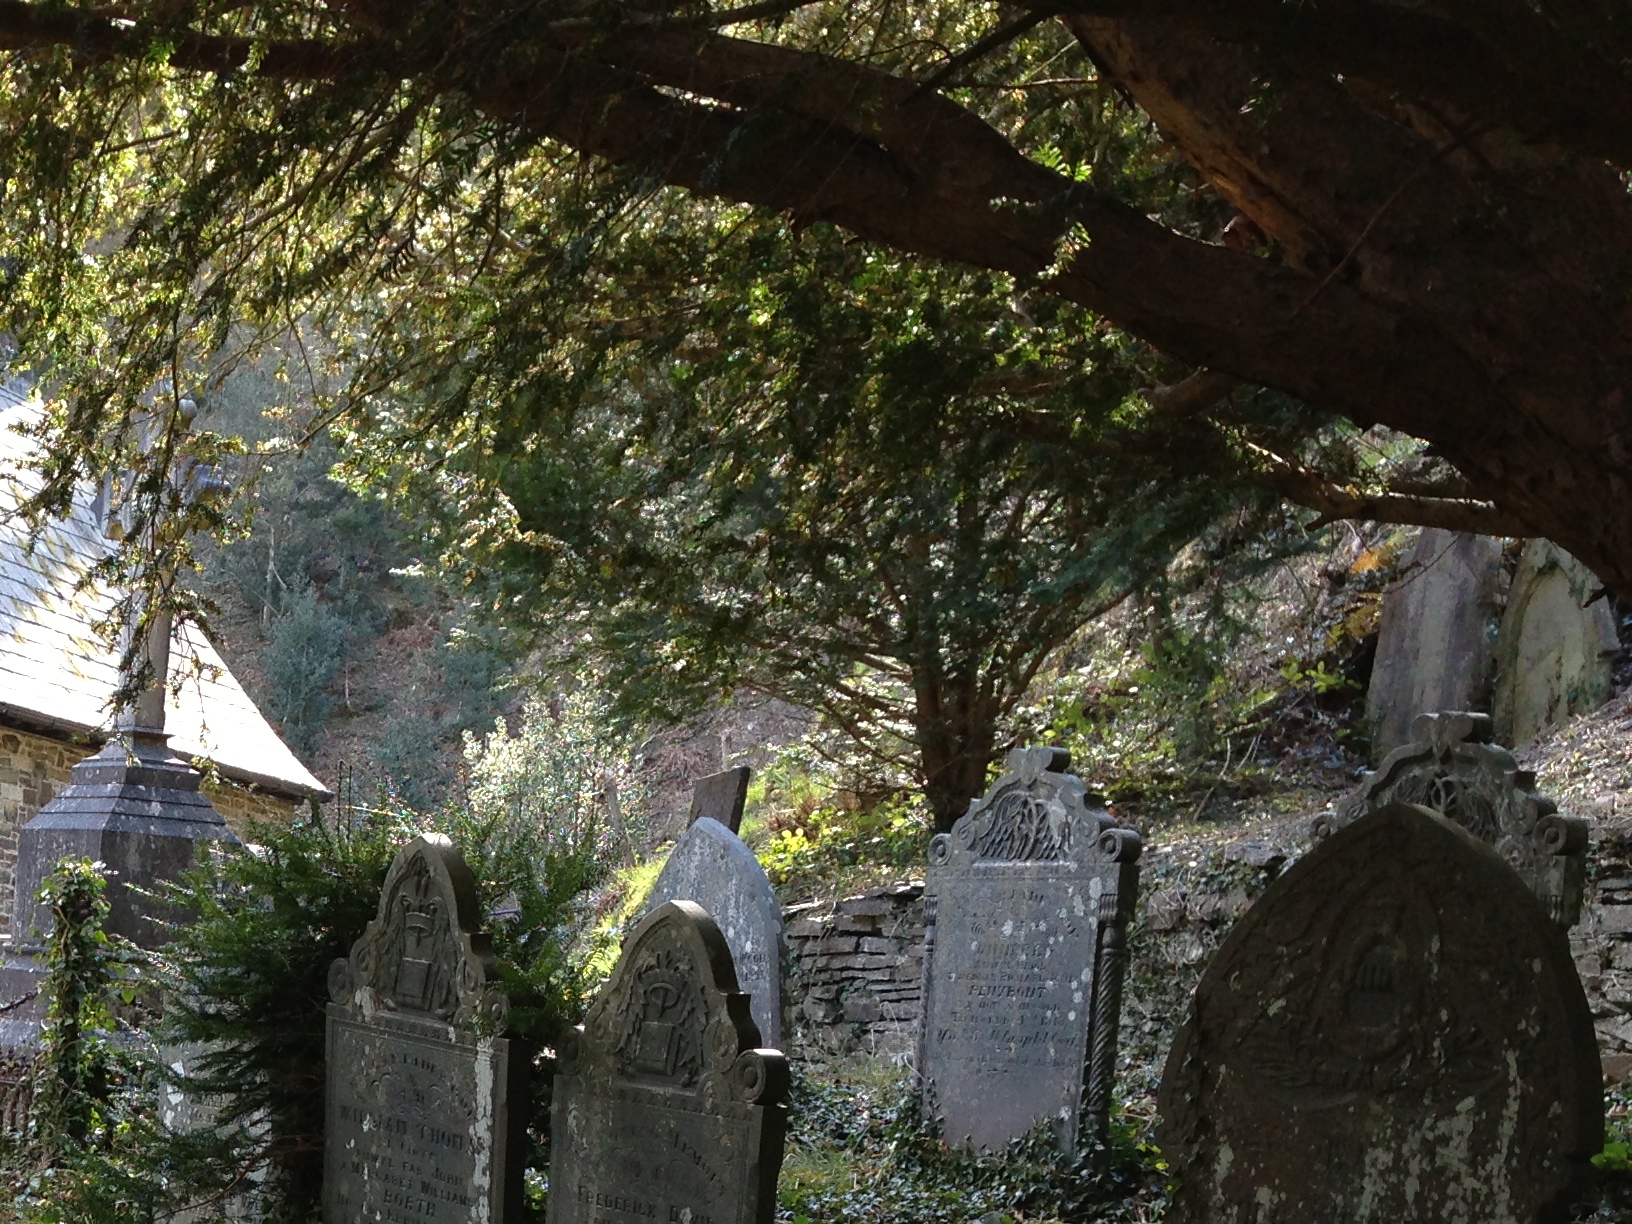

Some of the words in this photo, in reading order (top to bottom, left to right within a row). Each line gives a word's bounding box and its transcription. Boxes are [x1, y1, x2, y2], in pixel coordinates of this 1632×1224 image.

[339, 1104, 408, 1136] WILIAM
[383, 1189, 437, 1218] BORTH
[576, 1184, 657, 1219] FREDERICK
